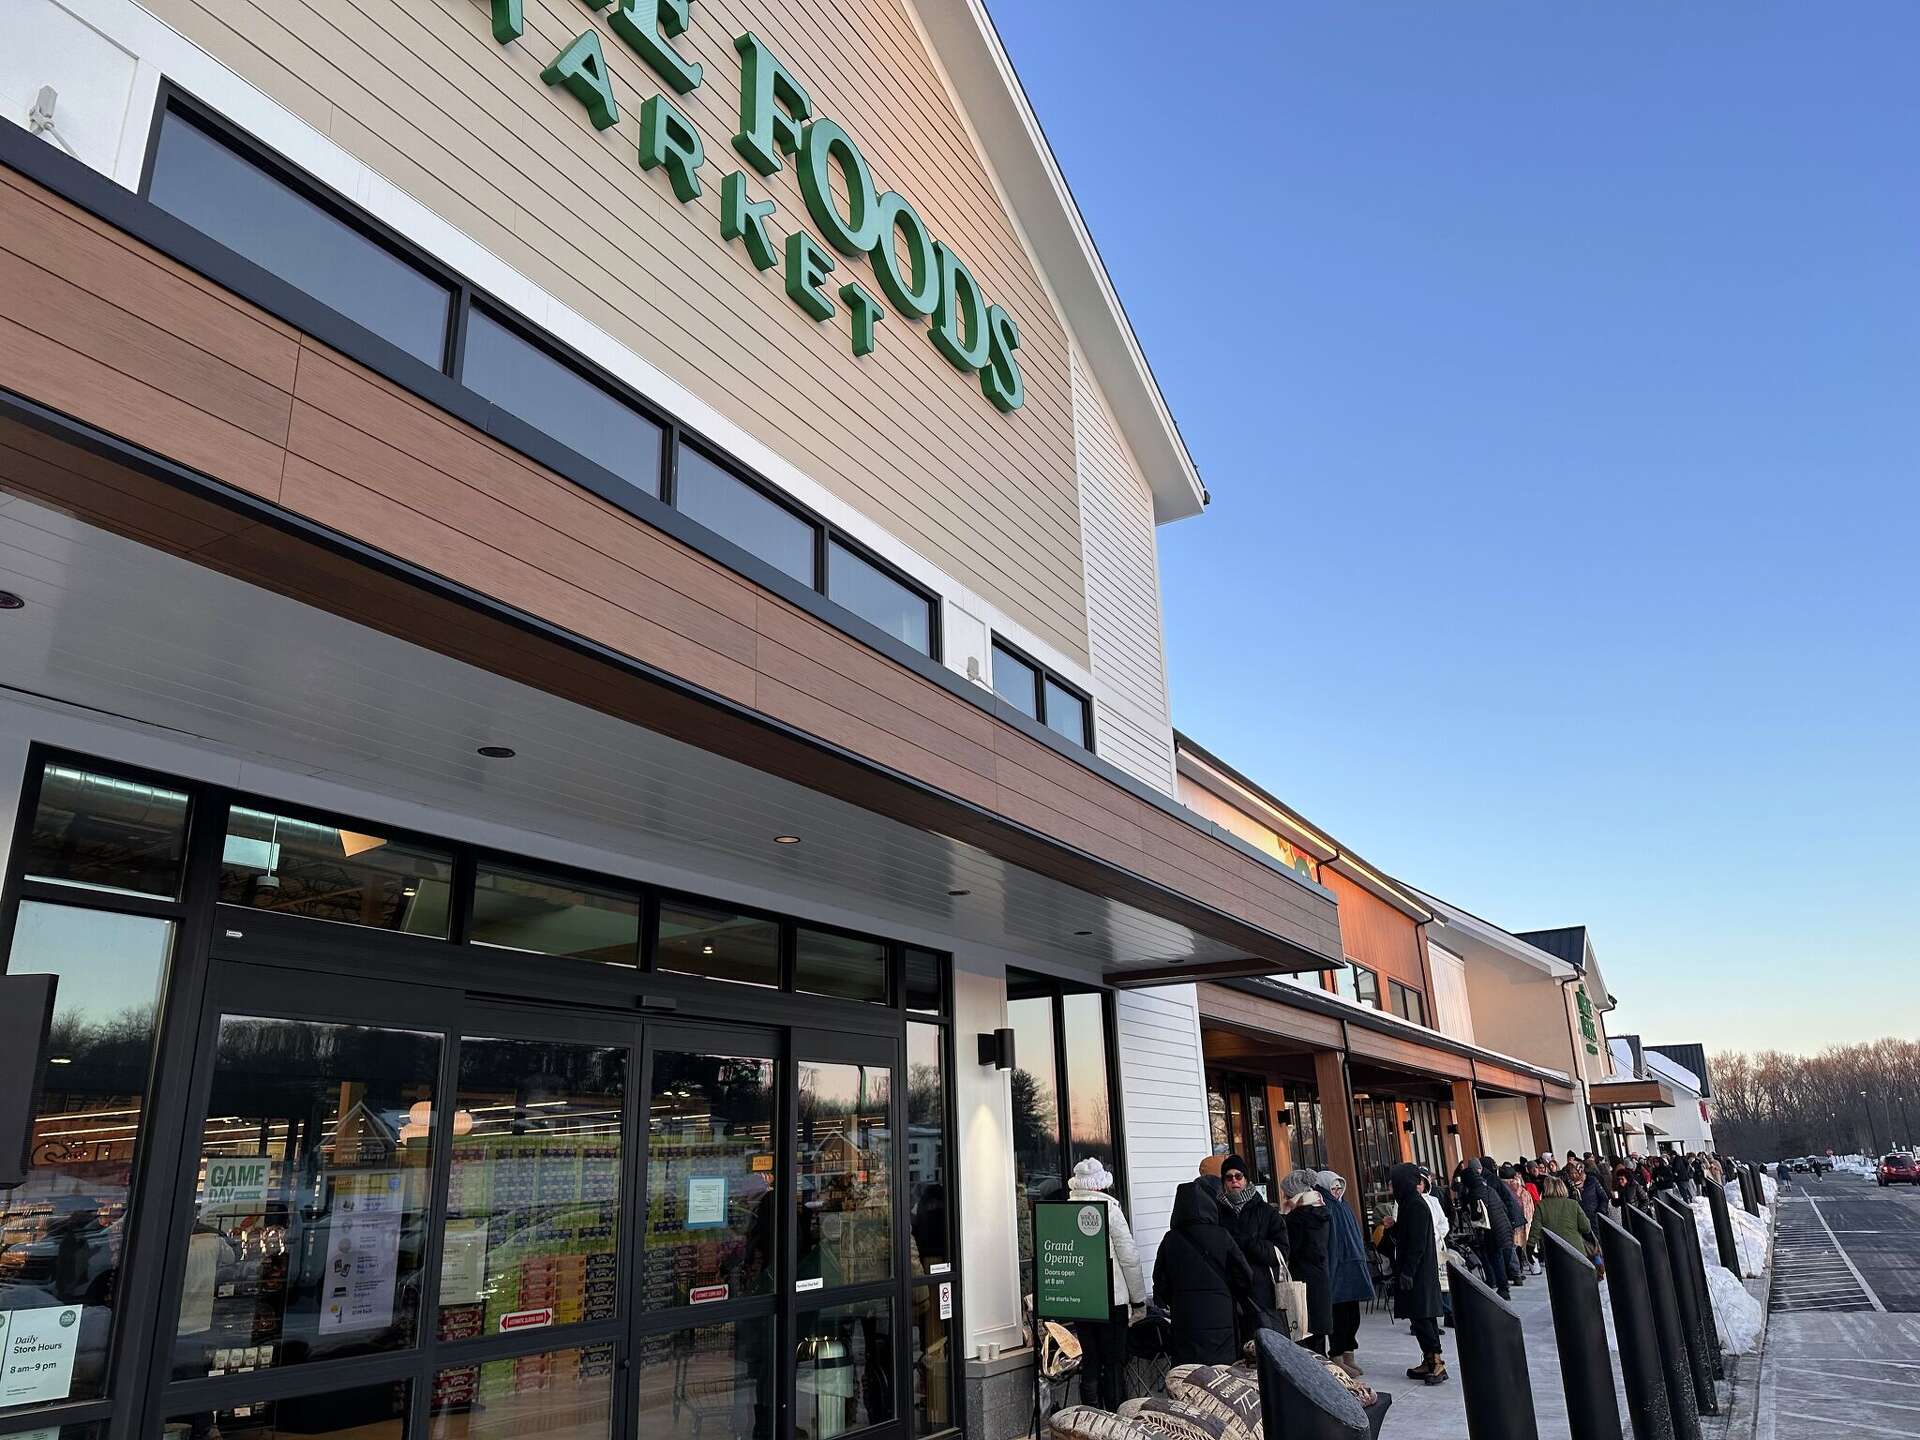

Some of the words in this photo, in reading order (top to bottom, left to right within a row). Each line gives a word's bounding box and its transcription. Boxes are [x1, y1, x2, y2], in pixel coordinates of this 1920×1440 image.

[731, 31, 1025, 413] FOODS
[211, 1165, 266, 1187] GAME
[208, 1187, 235, 1203] DAY
[1044, 1240, 1074, 1251] Grand
[1044, 1252, 1084, 1267] Opening
[15, 1335, 38, 1345] Daily
[13, 1345, 36, 1354] Store
[38, 1342, 62, 1352] Hours
[10, 1366, 16, 1374] 8
[42, 1362, 57, 1371] pm
